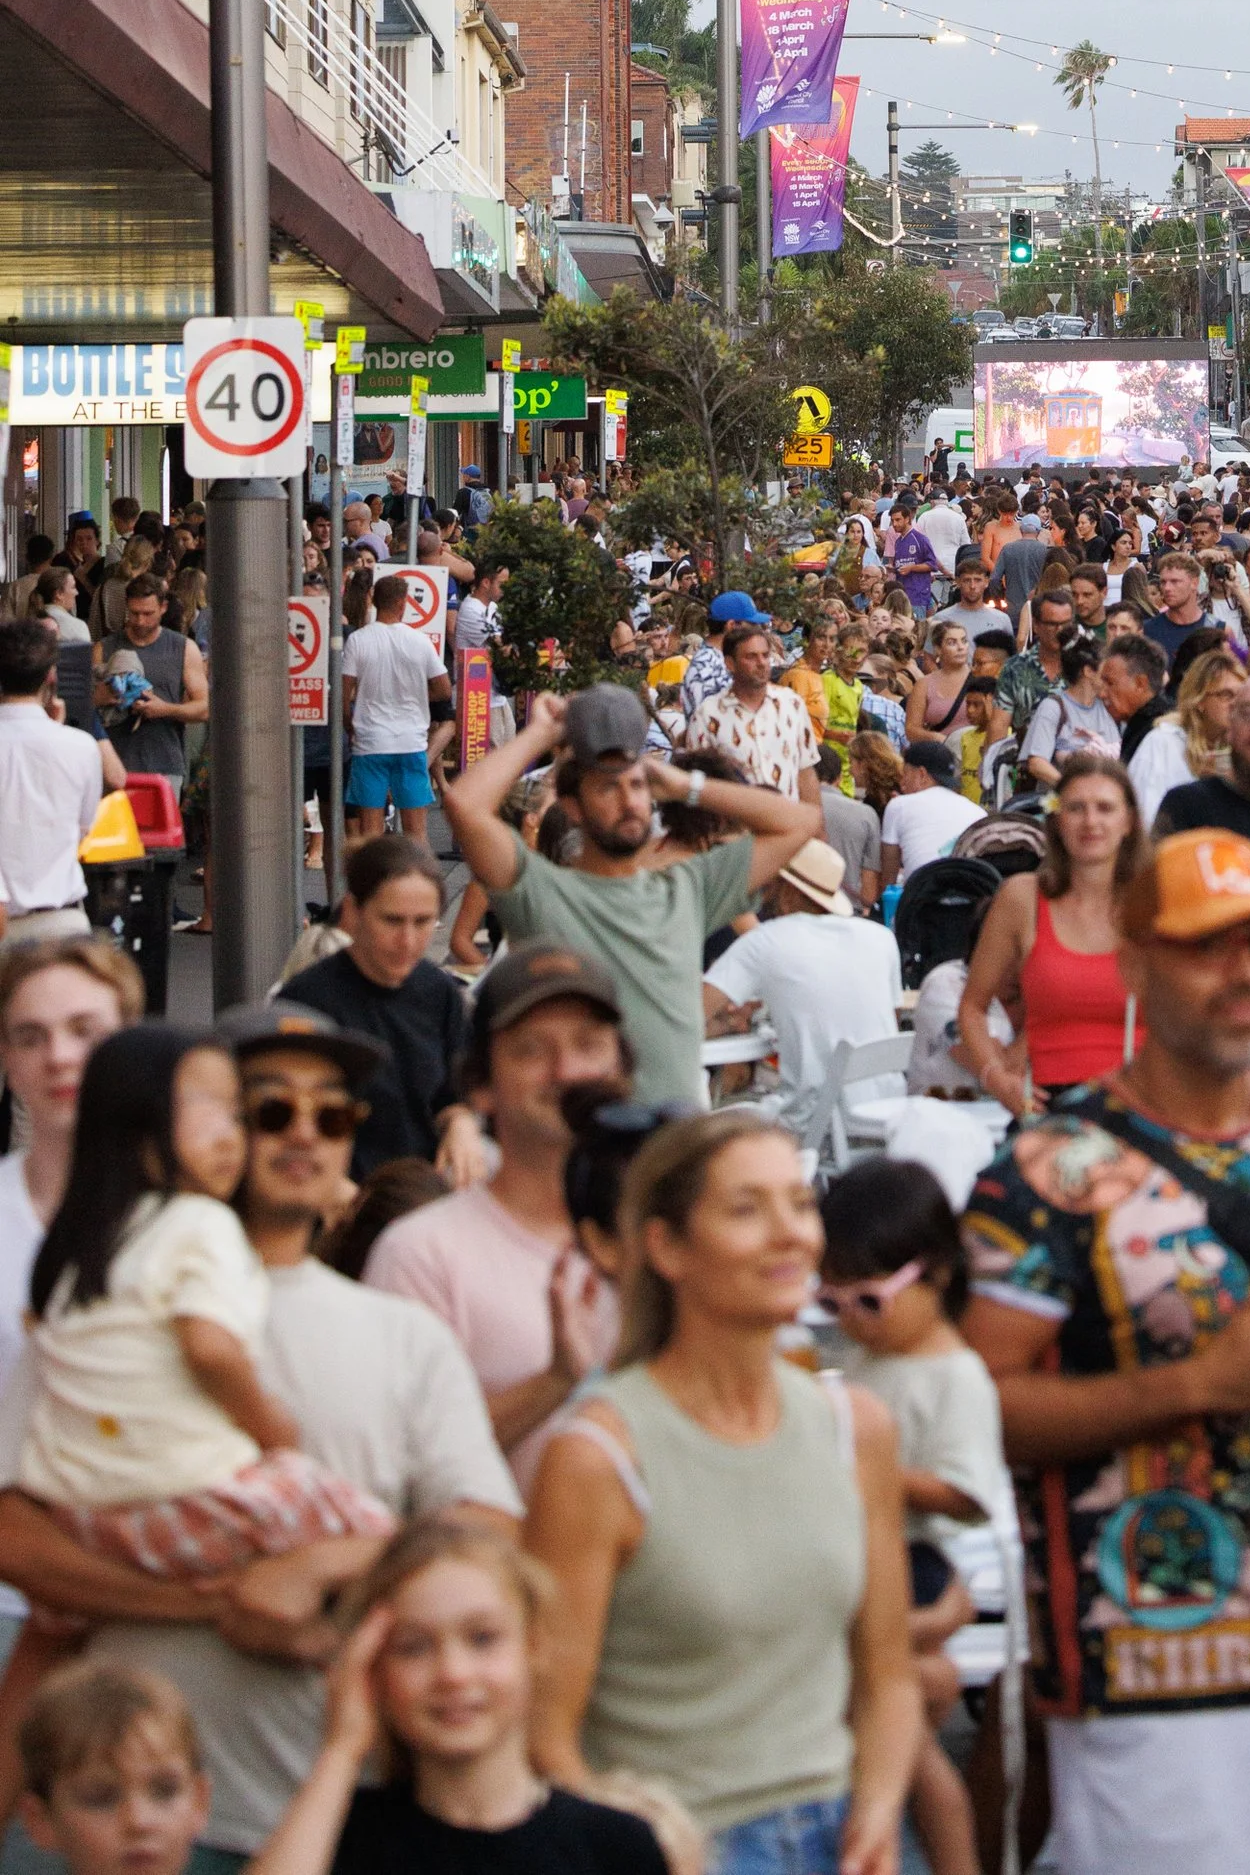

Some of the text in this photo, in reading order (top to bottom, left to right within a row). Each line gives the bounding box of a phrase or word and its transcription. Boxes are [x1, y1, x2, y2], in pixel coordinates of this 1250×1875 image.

[769, 12, 777, 21] 4
[784, 47, 808, 59] April
[800, 191, 818, 200] April
[802, 199, 820, 208] April
[363, 347, 455, 369] mbrero
[23, 345, 152, 396] BOTTLE
[205, 372, 285, 422] 40
[514, 380, 559, 415] op'
[73, 401, 102, 419] AT
[114, 401, 163, 419] THE
[796, 438, 823, 455] 25
[798, 456, 819, 464] km/h
[291, 678, 322, 691] LASS
[477, 691, 487, 715] BAY
[477, 718, 486, 743] THE
